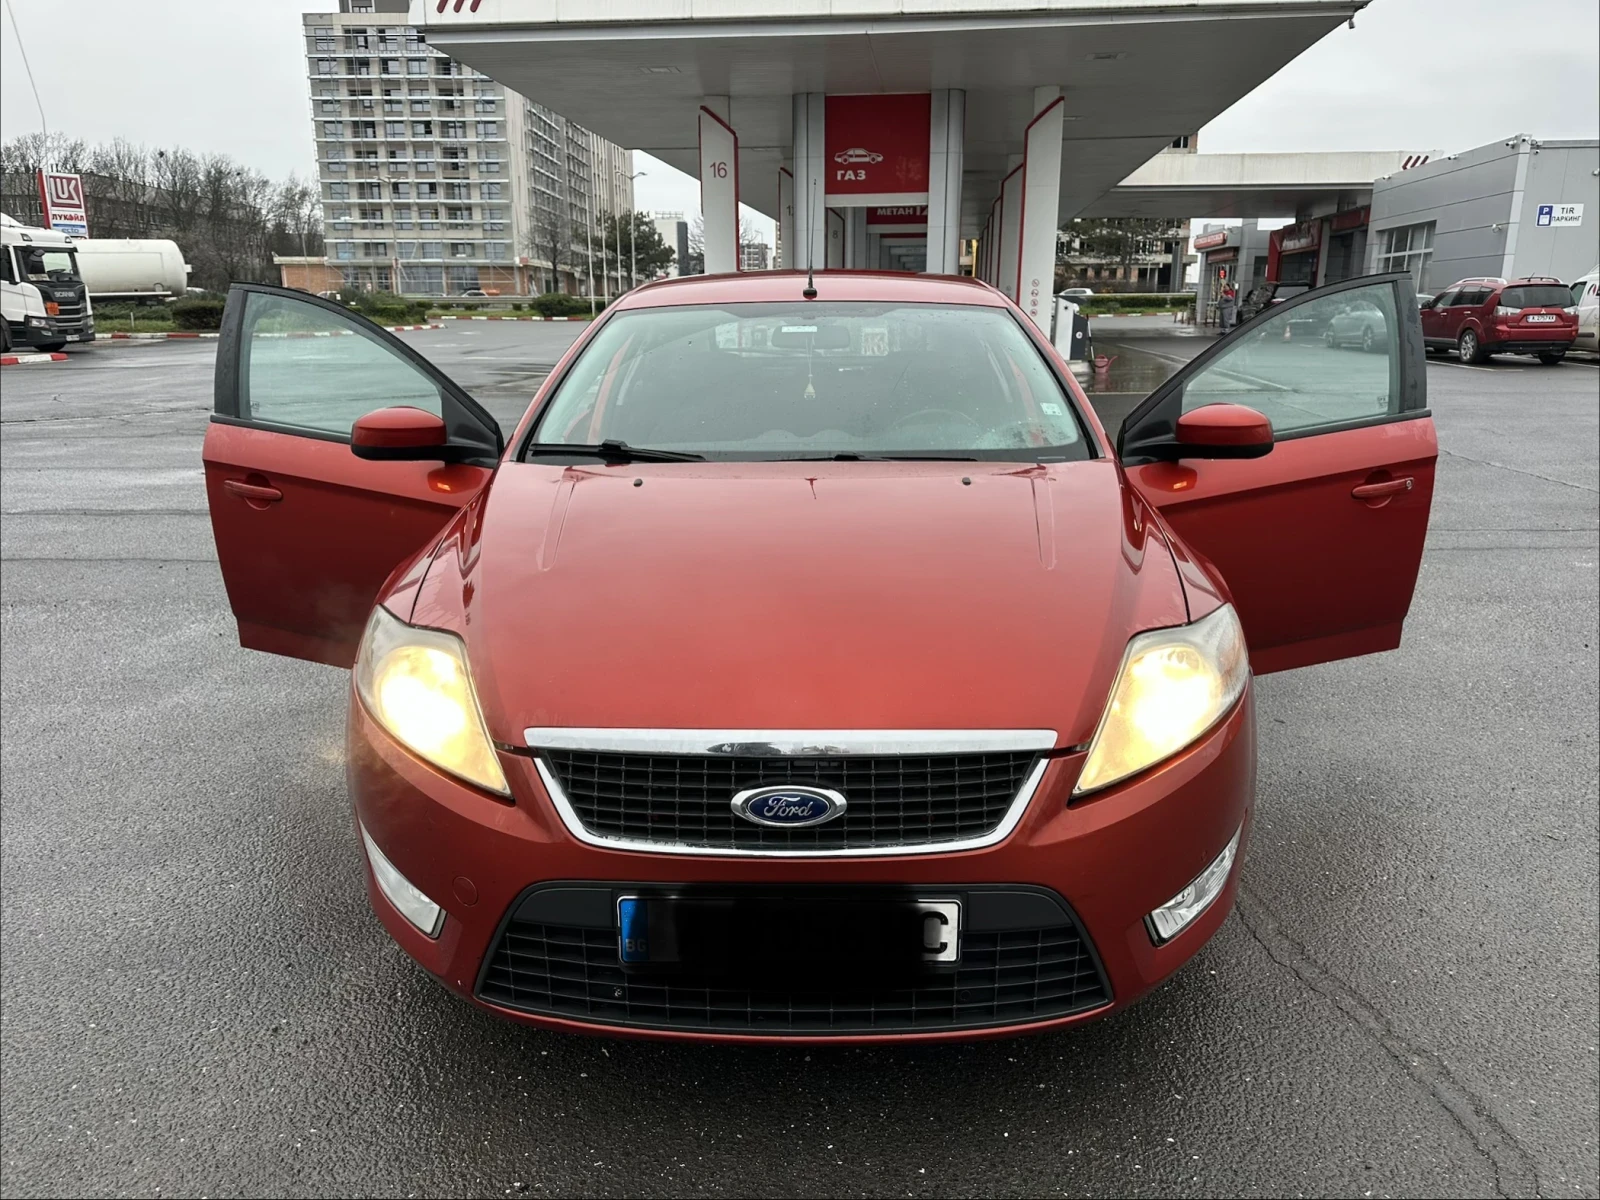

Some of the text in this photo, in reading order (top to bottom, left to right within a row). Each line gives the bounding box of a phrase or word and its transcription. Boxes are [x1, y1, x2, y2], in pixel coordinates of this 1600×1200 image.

[709, 161, 728, 179] 16
[836, 169, 867, 181] ГАЗ
[49, 177, 81, 205] LUK
[786, 205, 794, 217] 1
[876, 206, 913, 216] МЕТАН
[1542, 207, 1550, 215] P
[1561, 207, 1575, 215] TIR
[763, 796, 814, 817] Ford
